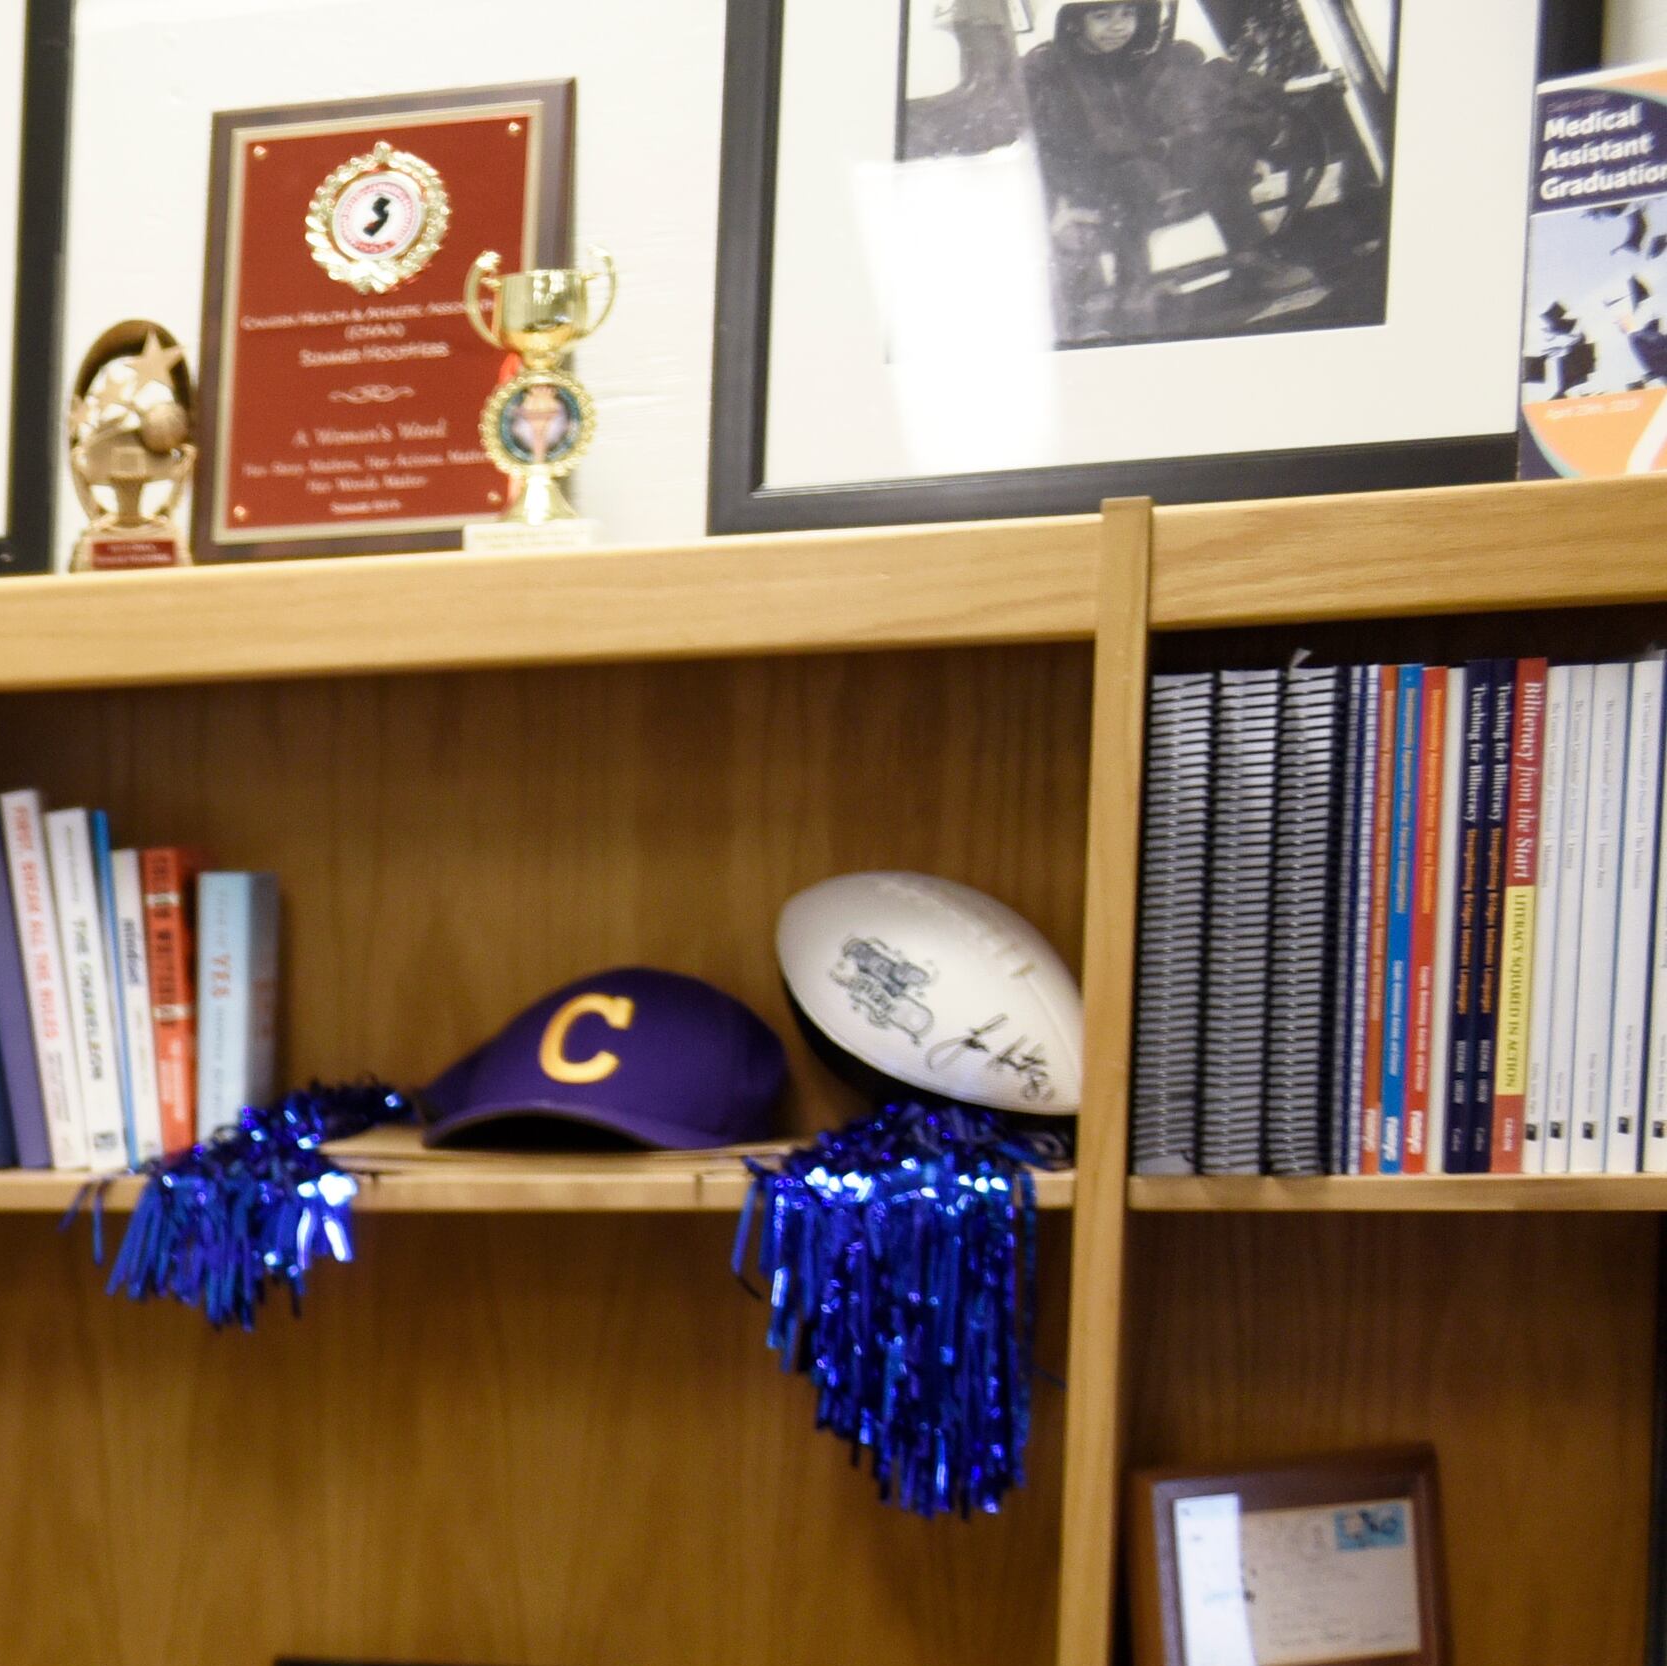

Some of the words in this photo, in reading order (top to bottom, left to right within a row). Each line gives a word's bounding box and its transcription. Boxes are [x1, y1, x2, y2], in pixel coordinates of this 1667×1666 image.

[1543, 102, 1644, 141] Medical
[1539, 131, 1656, 171] Assistant
[1468, 685, 1487, 740] Teaching
[1493, 683, 1512, 739] Teaching
[1512, 682, 1541, 760] Biliteracy
[1469, 744, 1483, 761] for
[1494, 743, 1509, 761] for
[1464, 765, 1483, 823] Biliteracy
[1489, 764, 1507, 821] Biliteracy
[1516, 766, 1538, 801] from
[1517, 809, 1534, 832] the
[1513, 837, 1531, 879] Start
[71, 918, 91, 956] THE
[1510, 894, 1529, 952] LITERACY
[32, 952, 52, 982] THE
[1508, 956, 1525, 1018] SQUARED
[538, 992, 634, 1084] C
[1508, 1021, 1521, 1035] IN
[1505, 1040, 1520, 1087] ACTION
